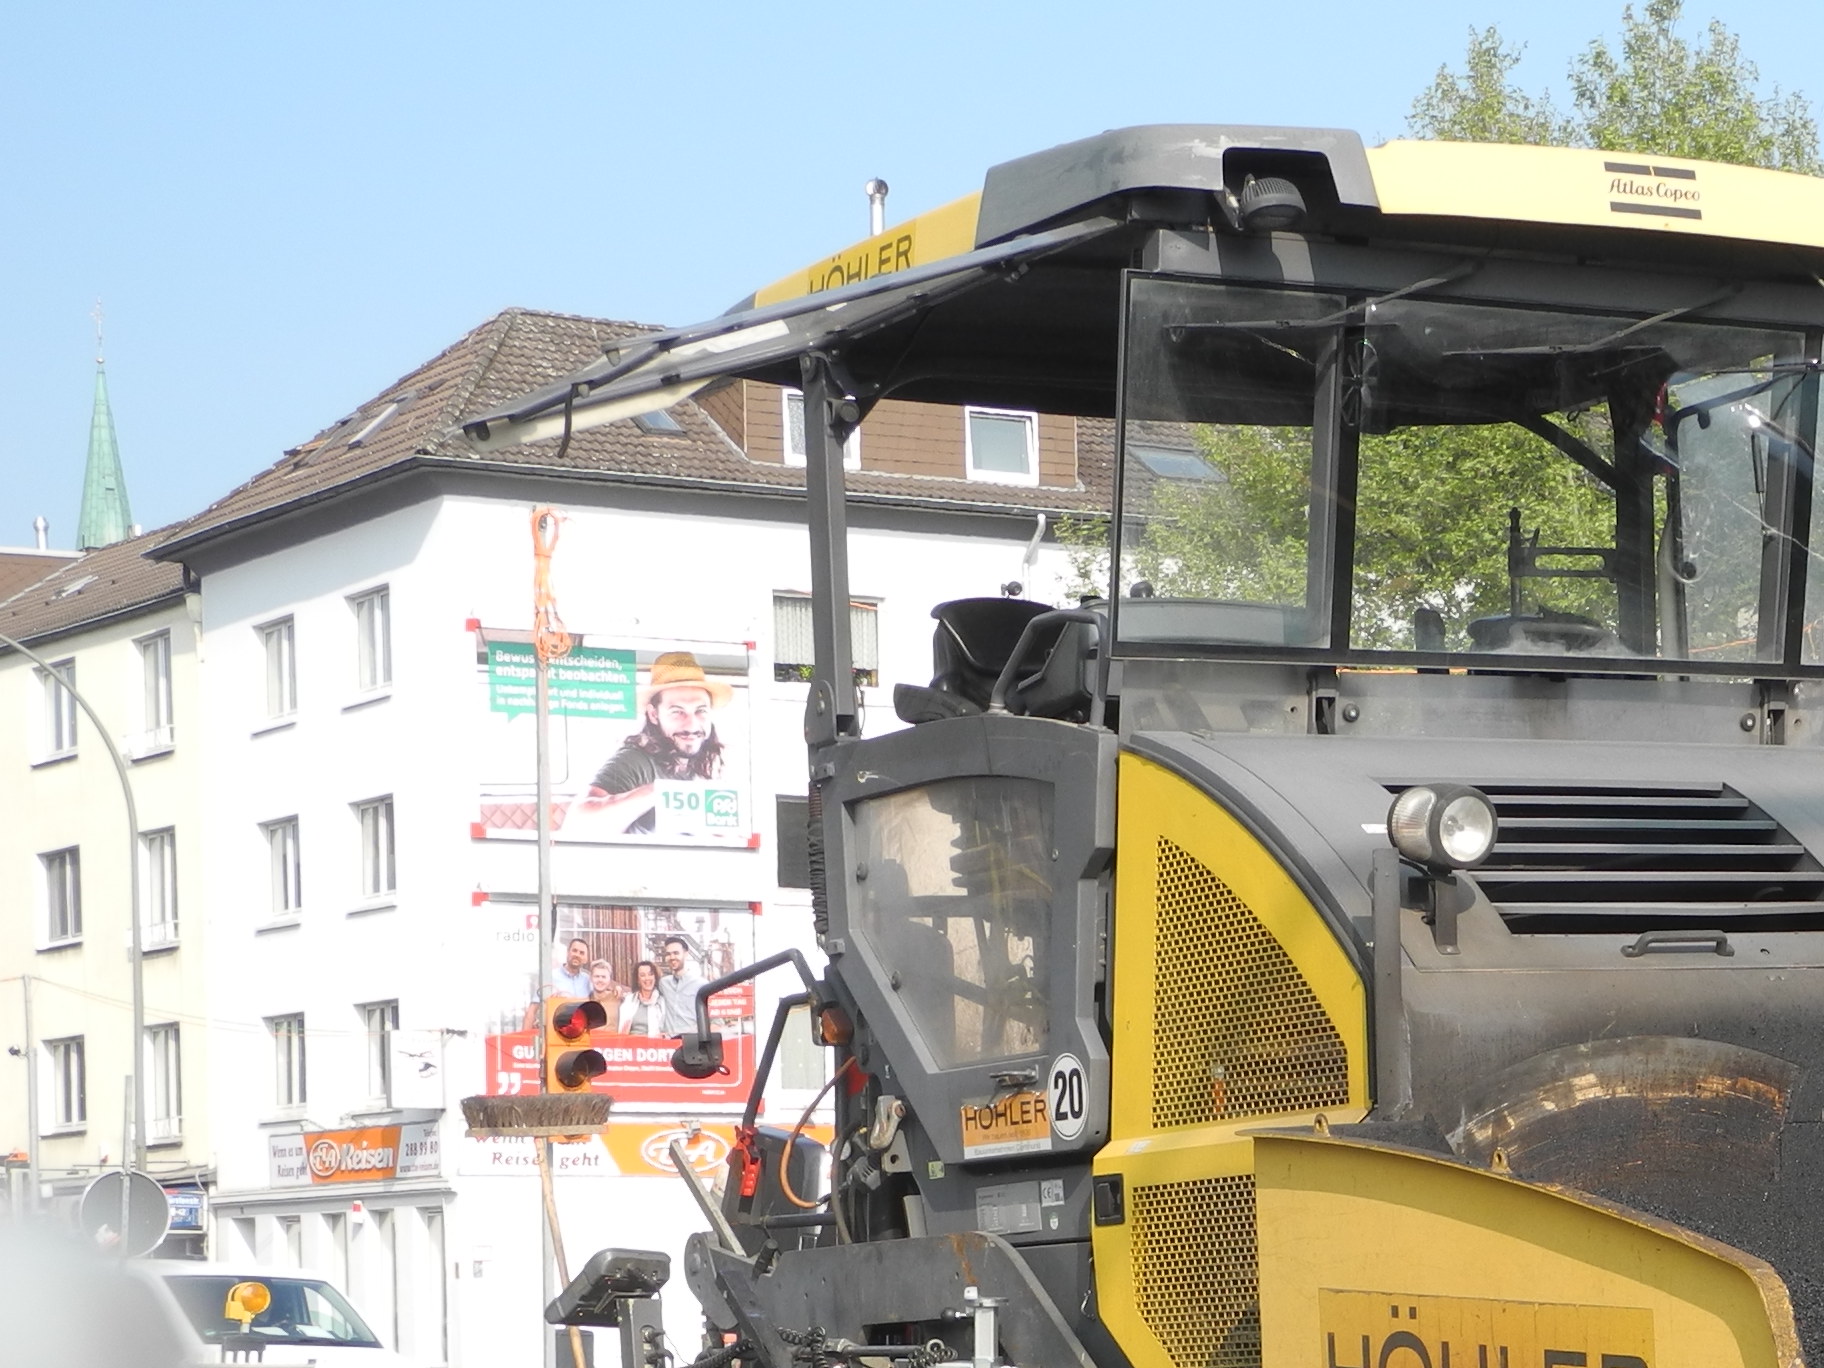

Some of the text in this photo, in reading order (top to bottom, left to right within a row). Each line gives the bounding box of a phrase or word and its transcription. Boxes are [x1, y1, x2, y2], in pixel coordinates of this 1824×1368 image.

[1608, 178, 1700, 203] Atlas Copco
[662, 791, 700, 811] 150
[496, 928, 535, 942] radio
[1054, 1067, 1084, 1122] 20
[340, 1140, 394, 1171] Reisen
[559, 1152, 600, 1170] geht
